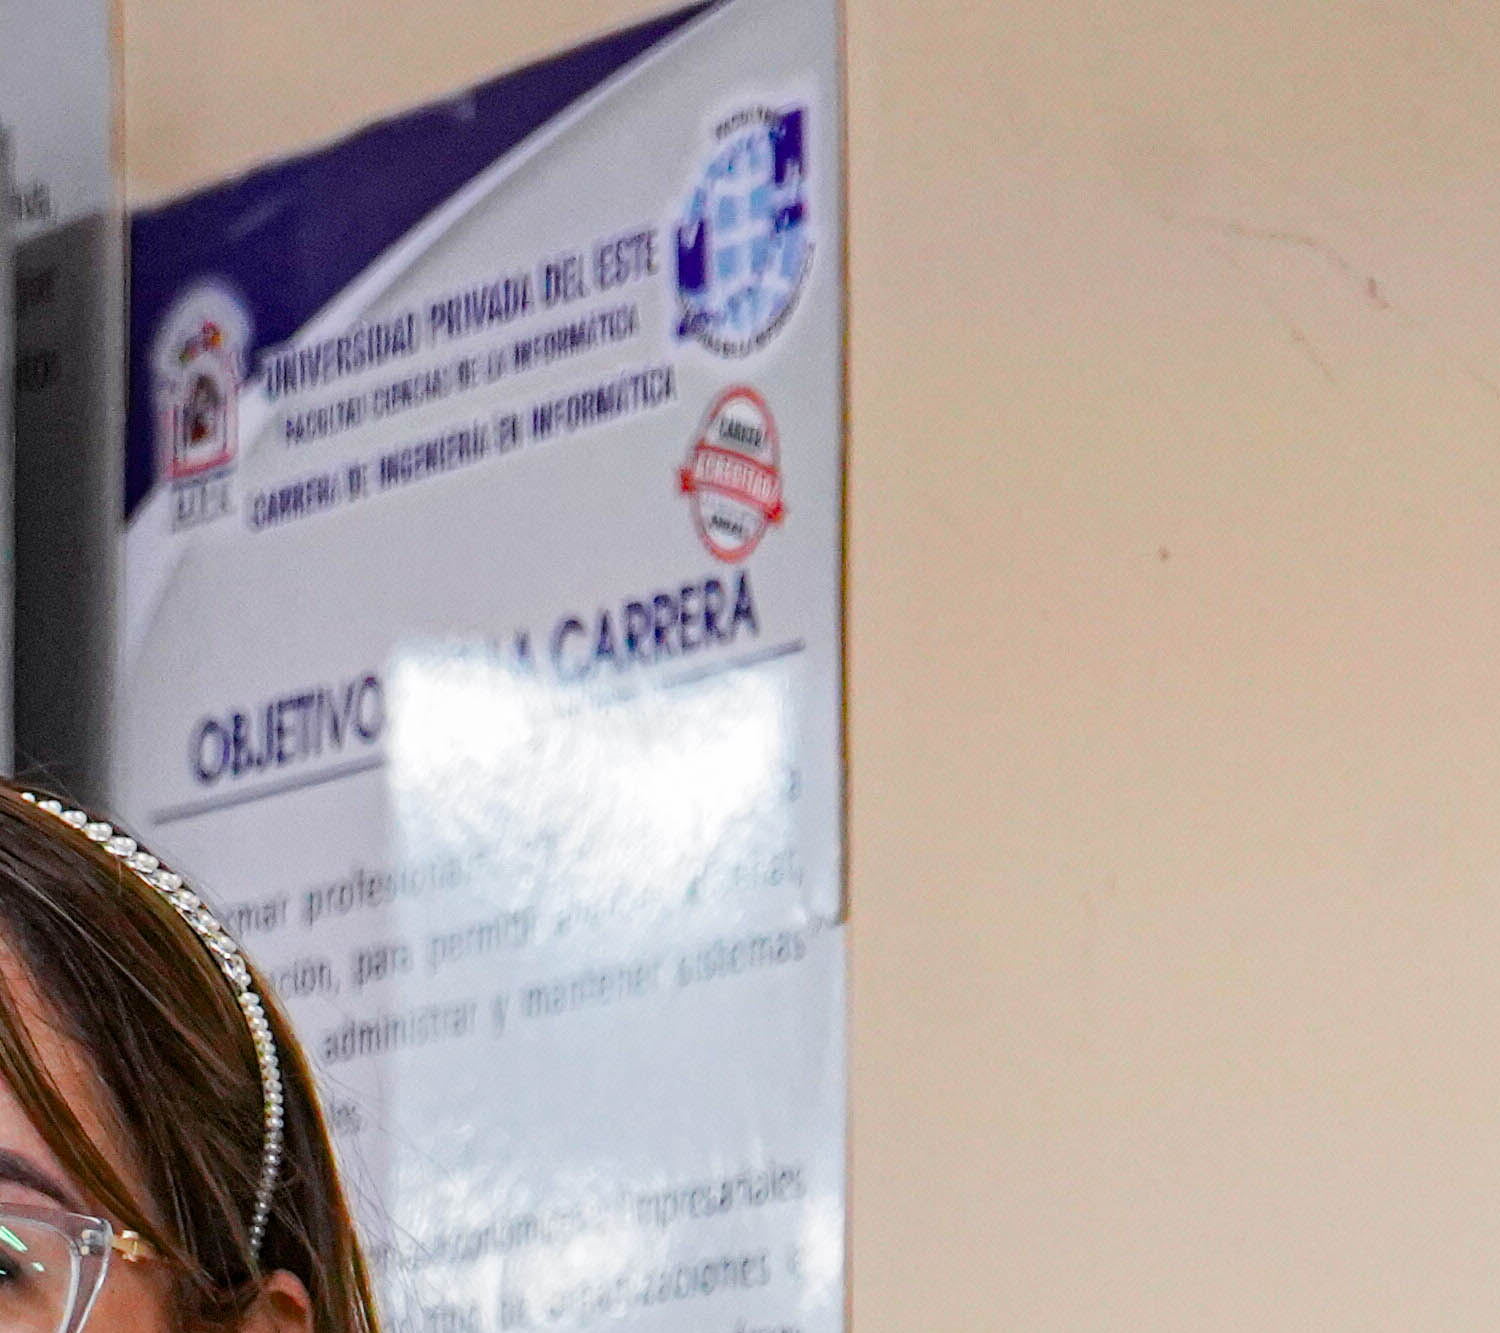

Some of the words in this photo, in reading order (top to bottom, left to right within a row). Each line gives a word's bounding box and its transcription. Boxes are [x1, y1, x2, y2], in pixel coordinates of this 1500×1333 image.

[267, 311, 416, 398] UNIVERSIDAD
[429, 273, 534, 340] PRIVADA
[543, 254, 584, 306] DEL
[592, 229, 659, 291] ESTE
[188, 671, 386, 786] OBJETIVO
[549, 568, 760, 687] CARRERA
[322, 1000, 477, 1066] administrar
[494, 991, 510, 1034] y
[521, 960, 660, 1019] mantener
[357, 946, 414, 989] para
